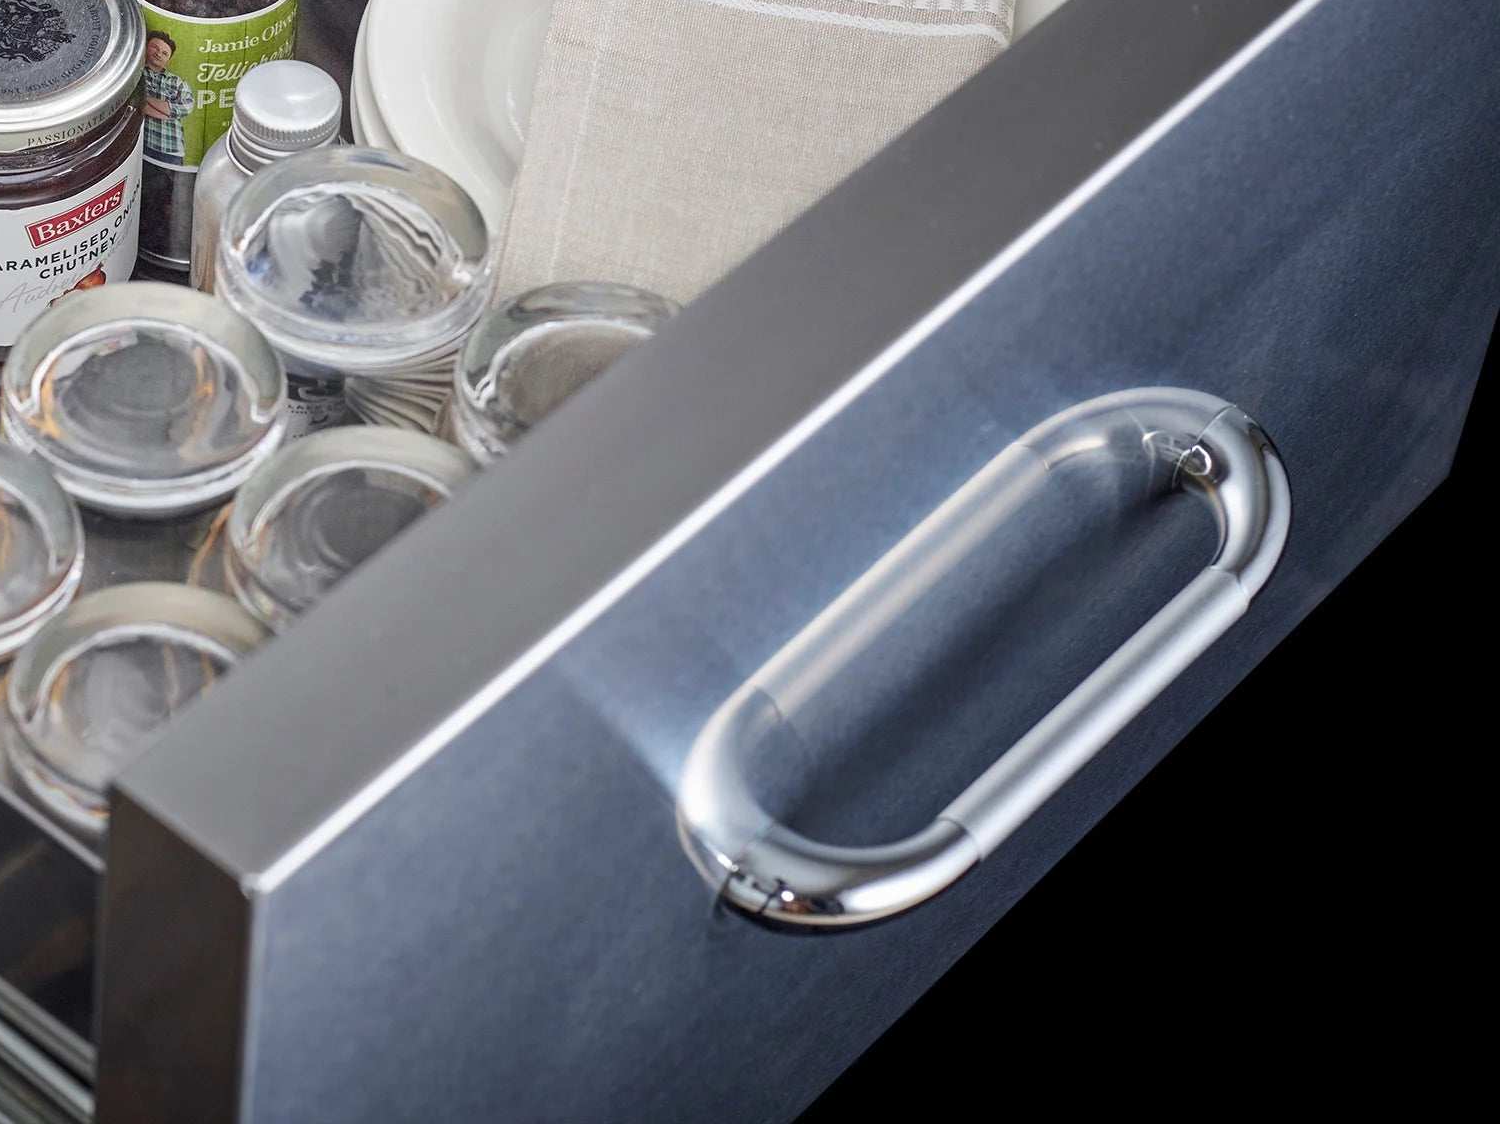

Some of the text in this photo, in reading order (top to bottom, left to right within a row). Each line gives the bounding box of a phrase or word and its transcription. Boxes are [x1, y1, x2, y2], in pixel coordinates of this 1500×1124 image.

[199, 35, 259, 53] Jamie
[27, 111, 104, 147] PASSIONATE
[37, 191, 121, 242] Baxters
[39, 233, 117, 279] CHUTNEY
